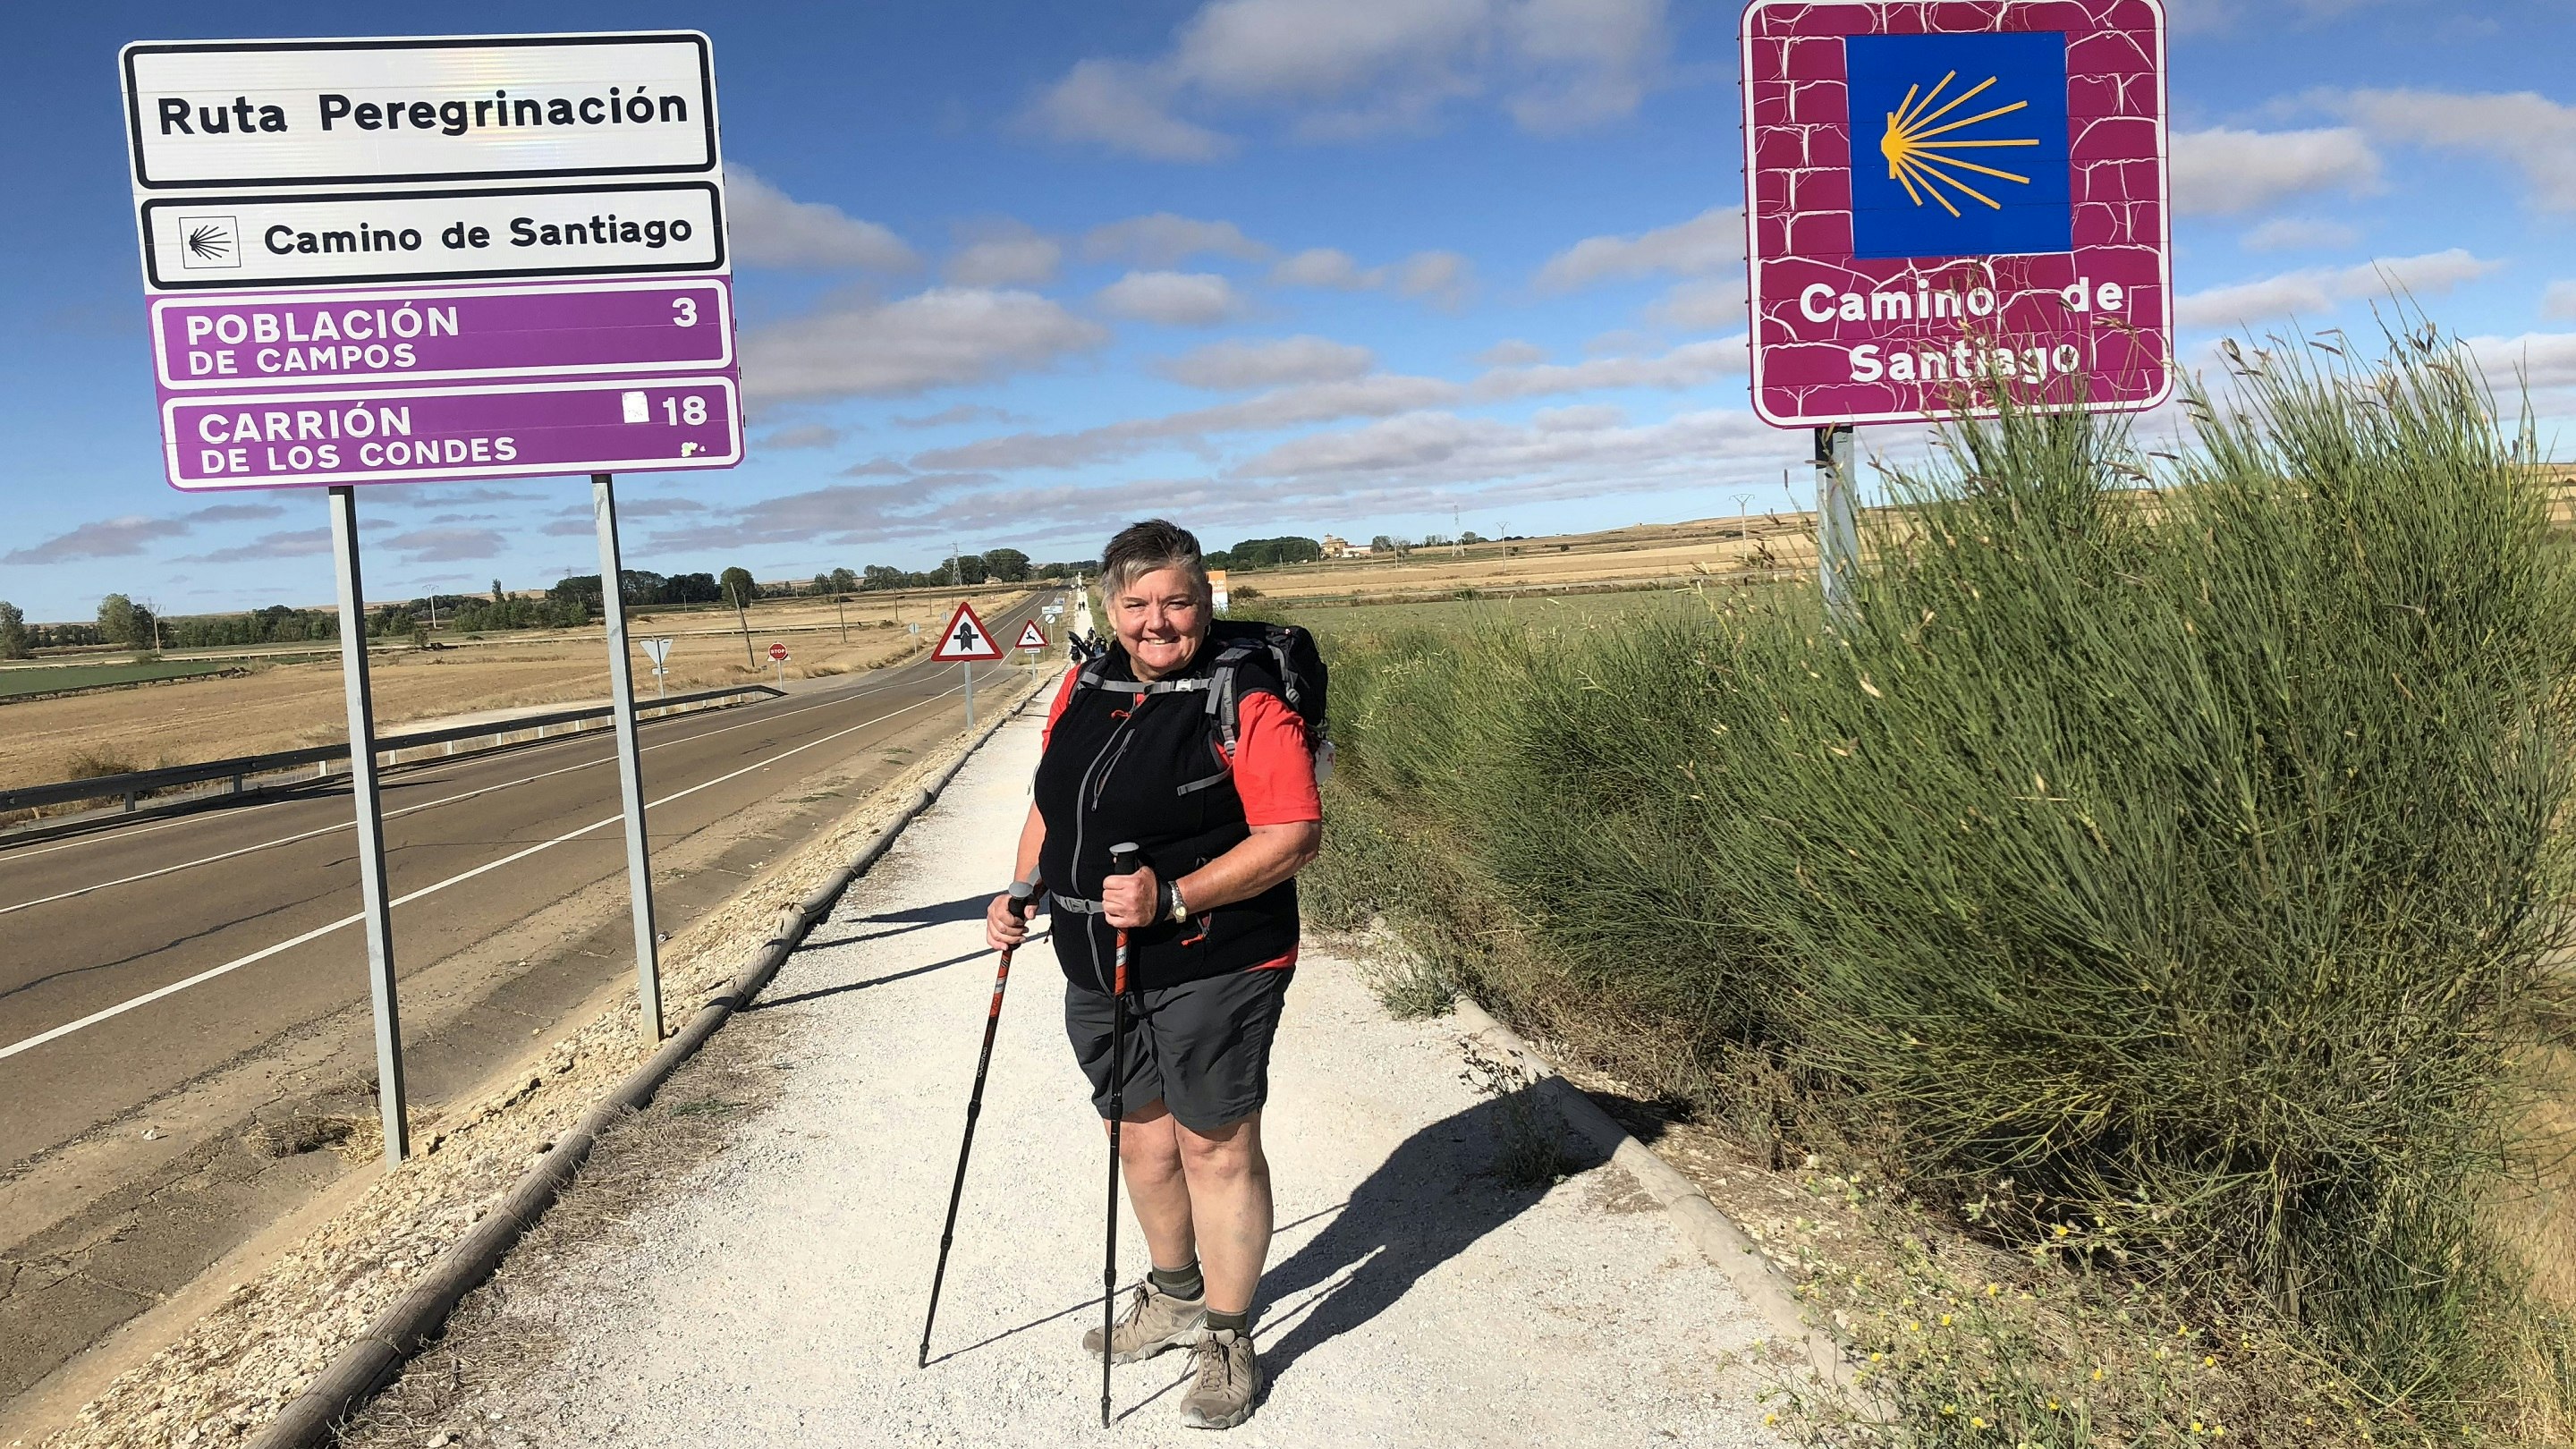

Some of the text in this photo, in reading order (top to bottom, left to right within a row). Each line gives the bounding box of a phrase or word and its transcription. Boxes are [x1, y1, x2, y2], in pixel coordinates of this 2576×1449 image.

[158, 86, 688, 137] Ruta Peregrinación
[265, 215, 692, 254] Camino de Santiago
[187, 298, 697, 345] POBLACIÓN 3
[1799, 276, 2124, 323] Camino de
[189, 343, 417, 376] DE CAMPOS
[1849, 336, 2080, 385] Santiago
[199, 396, 707, 445] CARRIÓN 18
[201, 437, 517, 473] DE LOS CONDES
